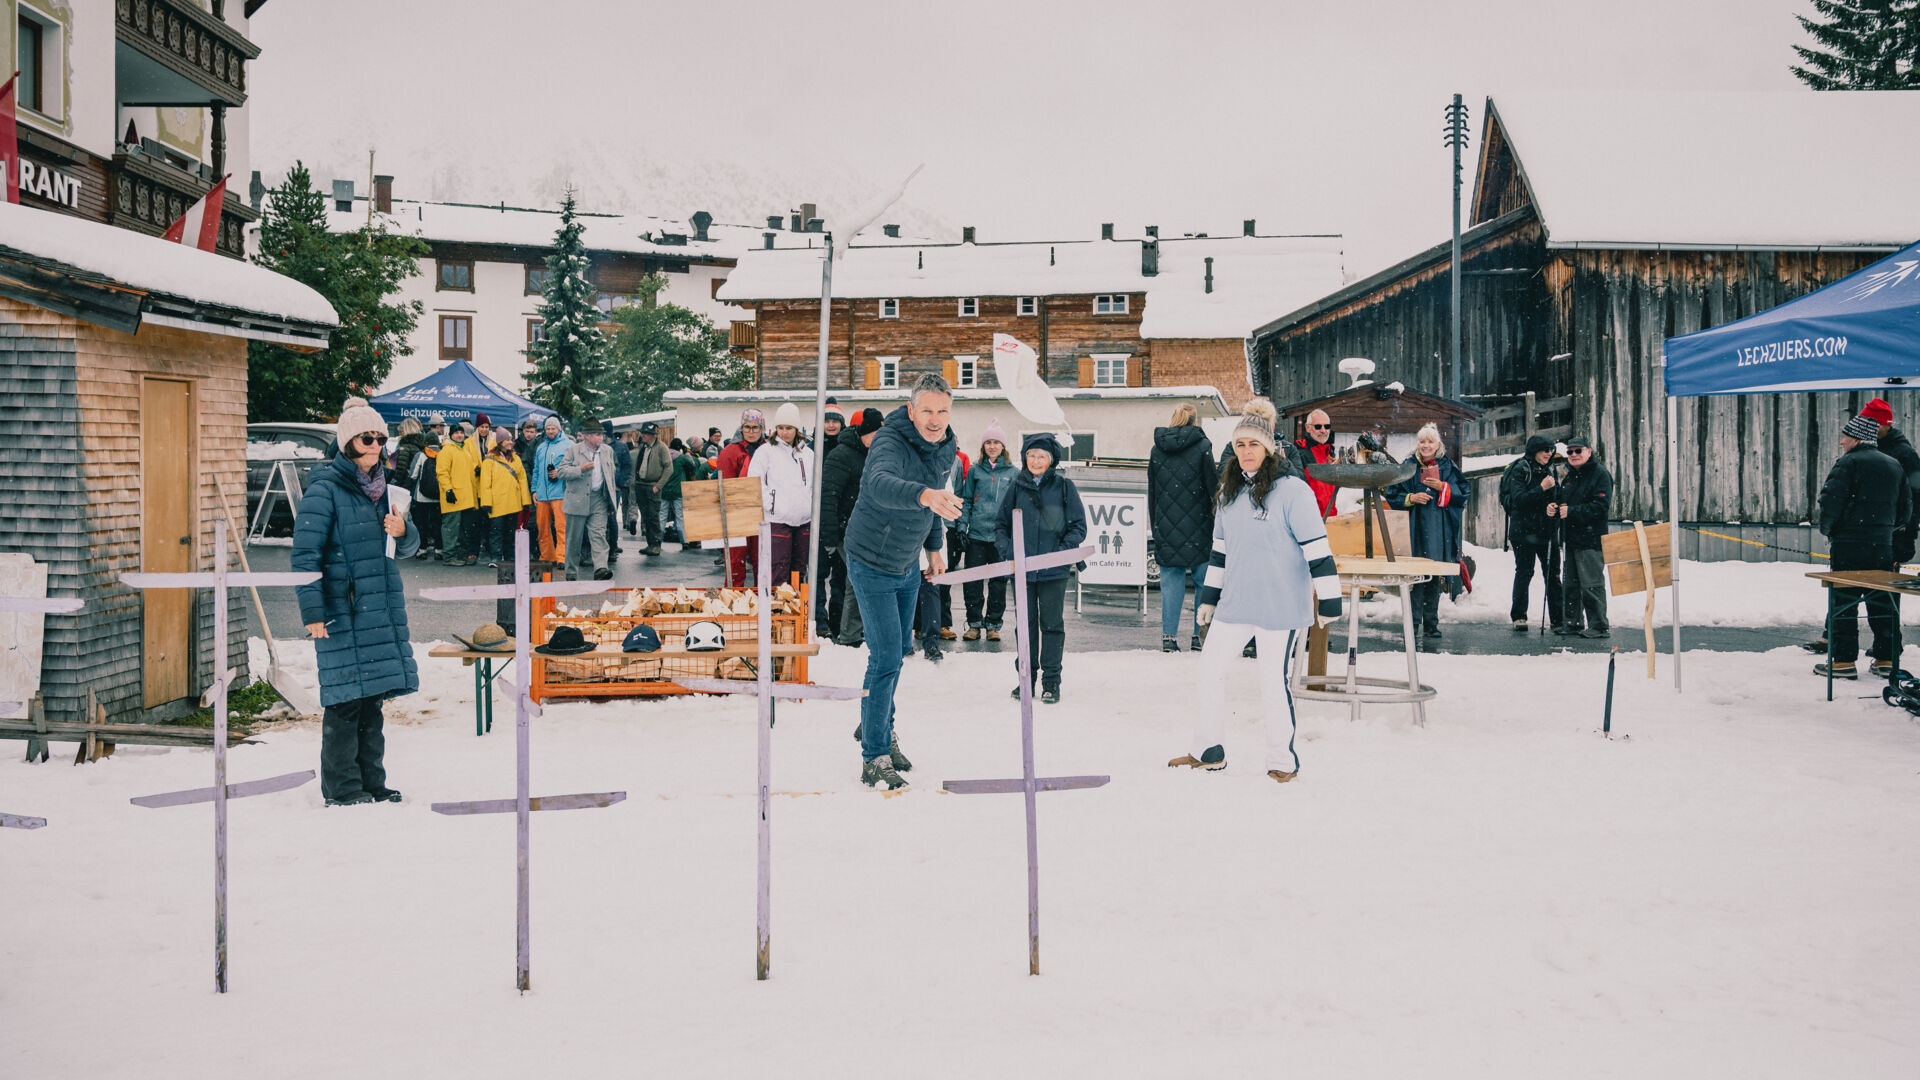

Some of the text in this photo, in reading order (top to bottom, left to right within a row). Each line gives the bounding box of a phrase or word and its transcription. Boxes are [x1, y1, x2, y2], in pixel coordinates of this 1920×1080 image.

[1737, 336, 1848, 367] LECHZUERS.COM
[406, 386, 438, 395] Lech
[400, 407, 471, 418] lechzuers.com
[1088, 504, 1135, 526] WC
[1116, 560, 1132, 568] Fritz
